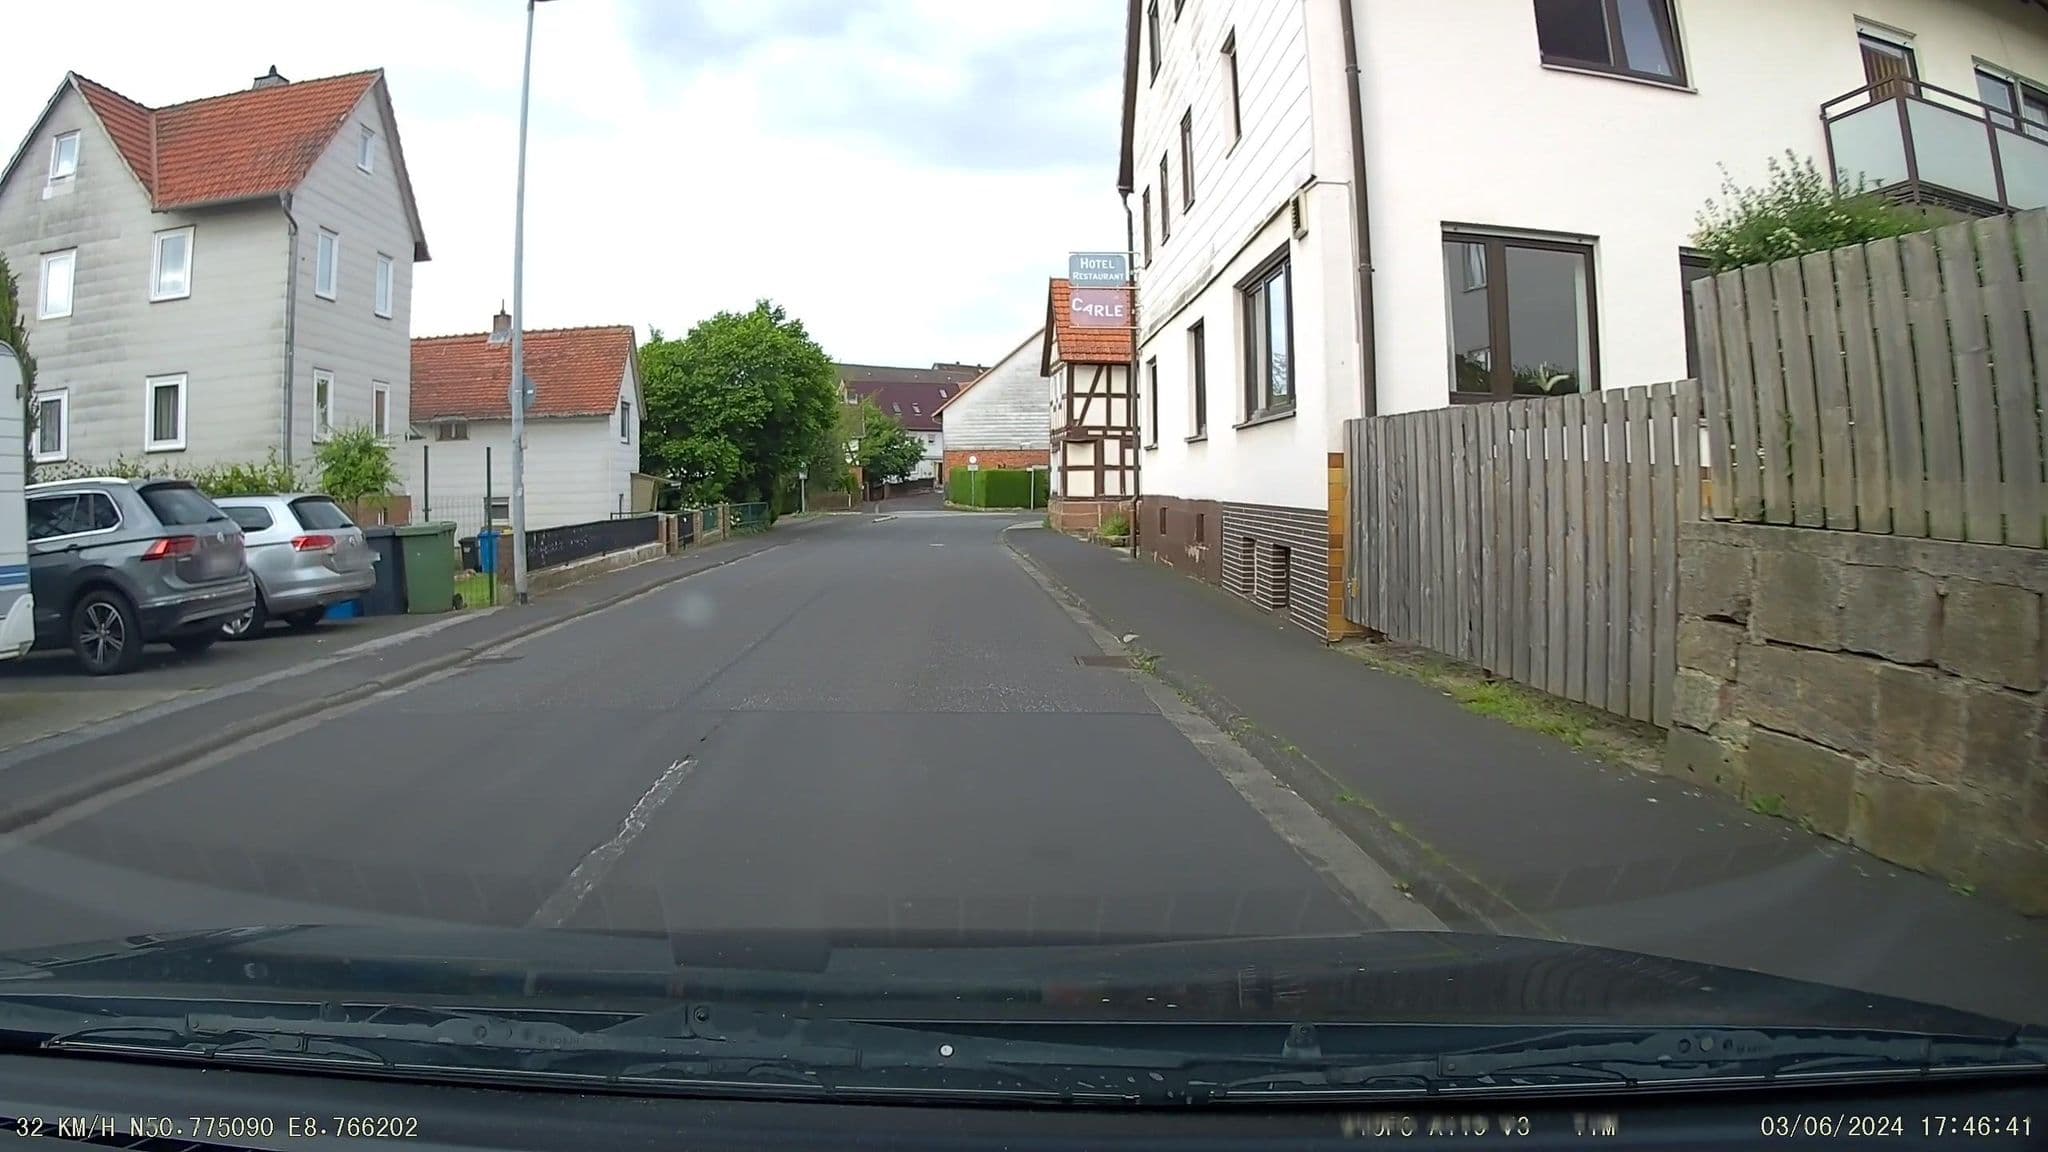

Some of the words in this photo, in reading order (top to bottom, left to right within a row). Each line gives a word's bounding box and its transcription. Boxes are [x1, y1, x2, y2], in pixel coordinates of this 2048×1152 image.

[1080, 257, 1115, 269] HOTEL
[1072, 272, 1124, 280] RESTAURANT
[1072, 297, 1124, 317] CARLE
